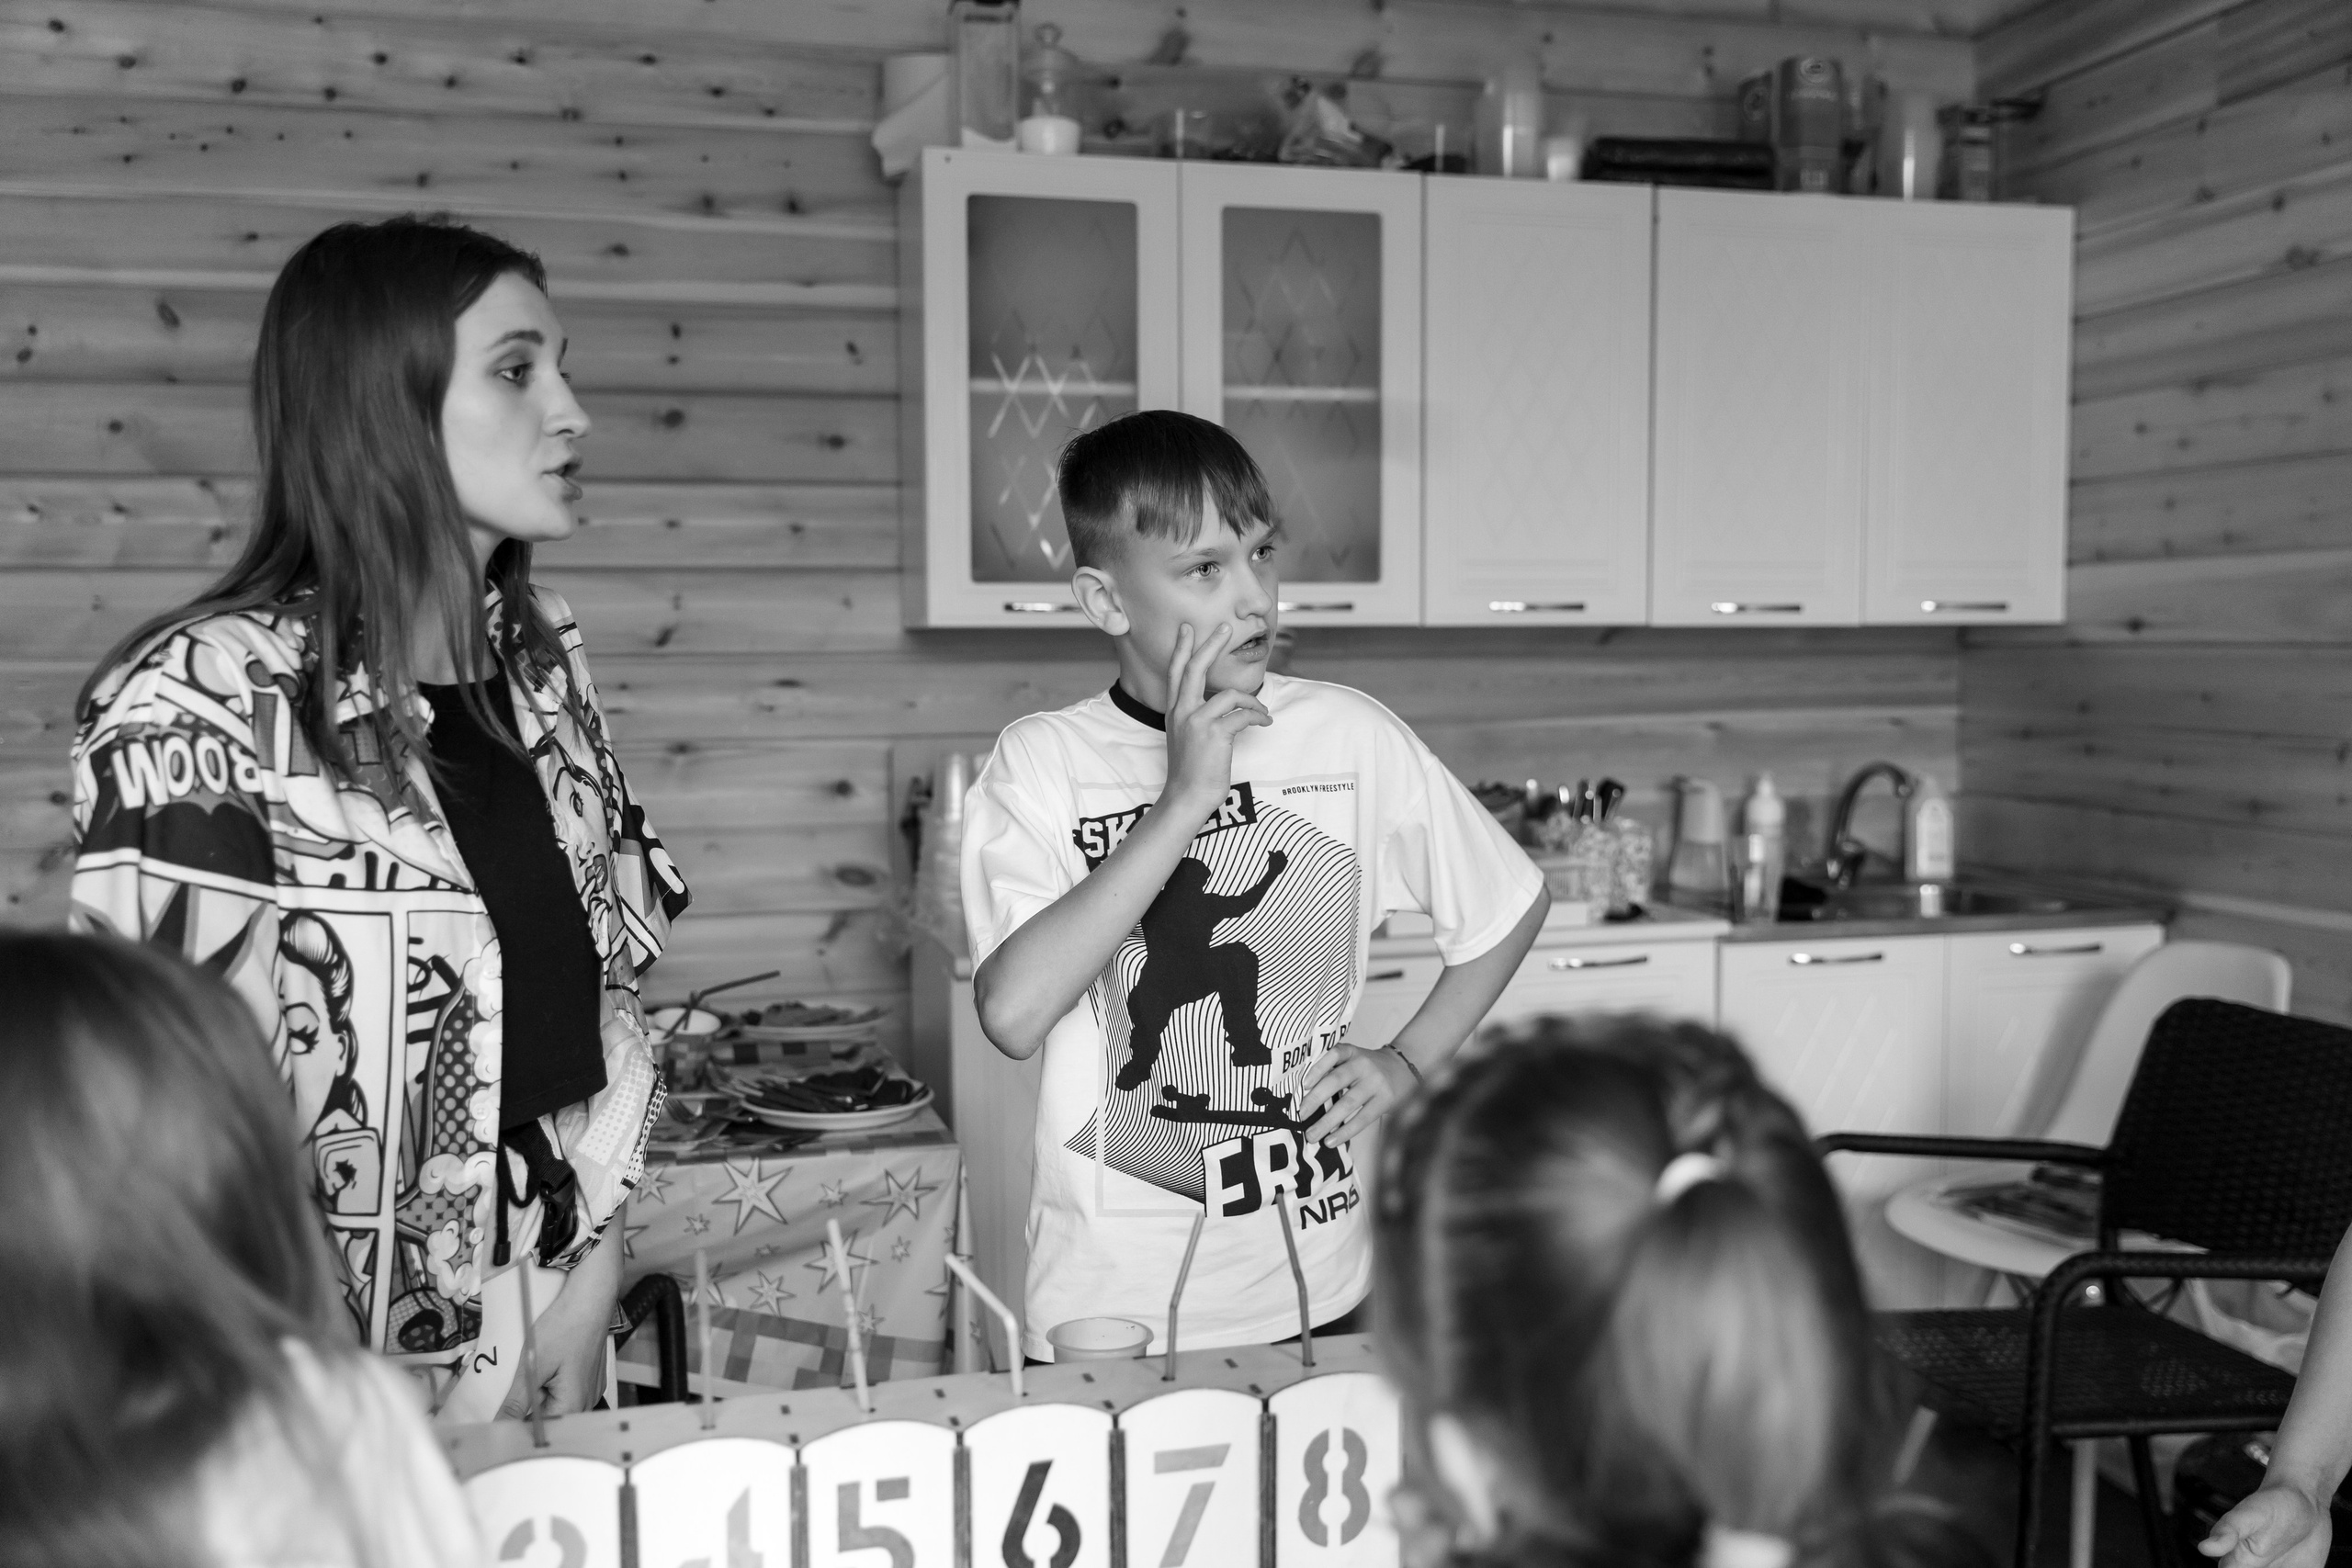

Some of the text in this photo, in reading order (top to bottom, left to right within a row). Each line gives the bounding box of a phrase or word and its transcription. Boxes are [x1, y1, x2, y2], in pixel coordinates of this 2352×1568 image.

[1282, 782, 1354, 796] BROOKLYN FREESTYLE
[1081, 787, 1248, 859] SKR
[1320, 1030, 1337, 1054] TO
[474, 1346, 497, 1374] 2
[837, 1477, 916, 1568] 5
[1001, 1459, 1081, 1568] 6
[1153, 1443, 1231, 1568] 7
[1298, 1427, 1371, 1548] 8
